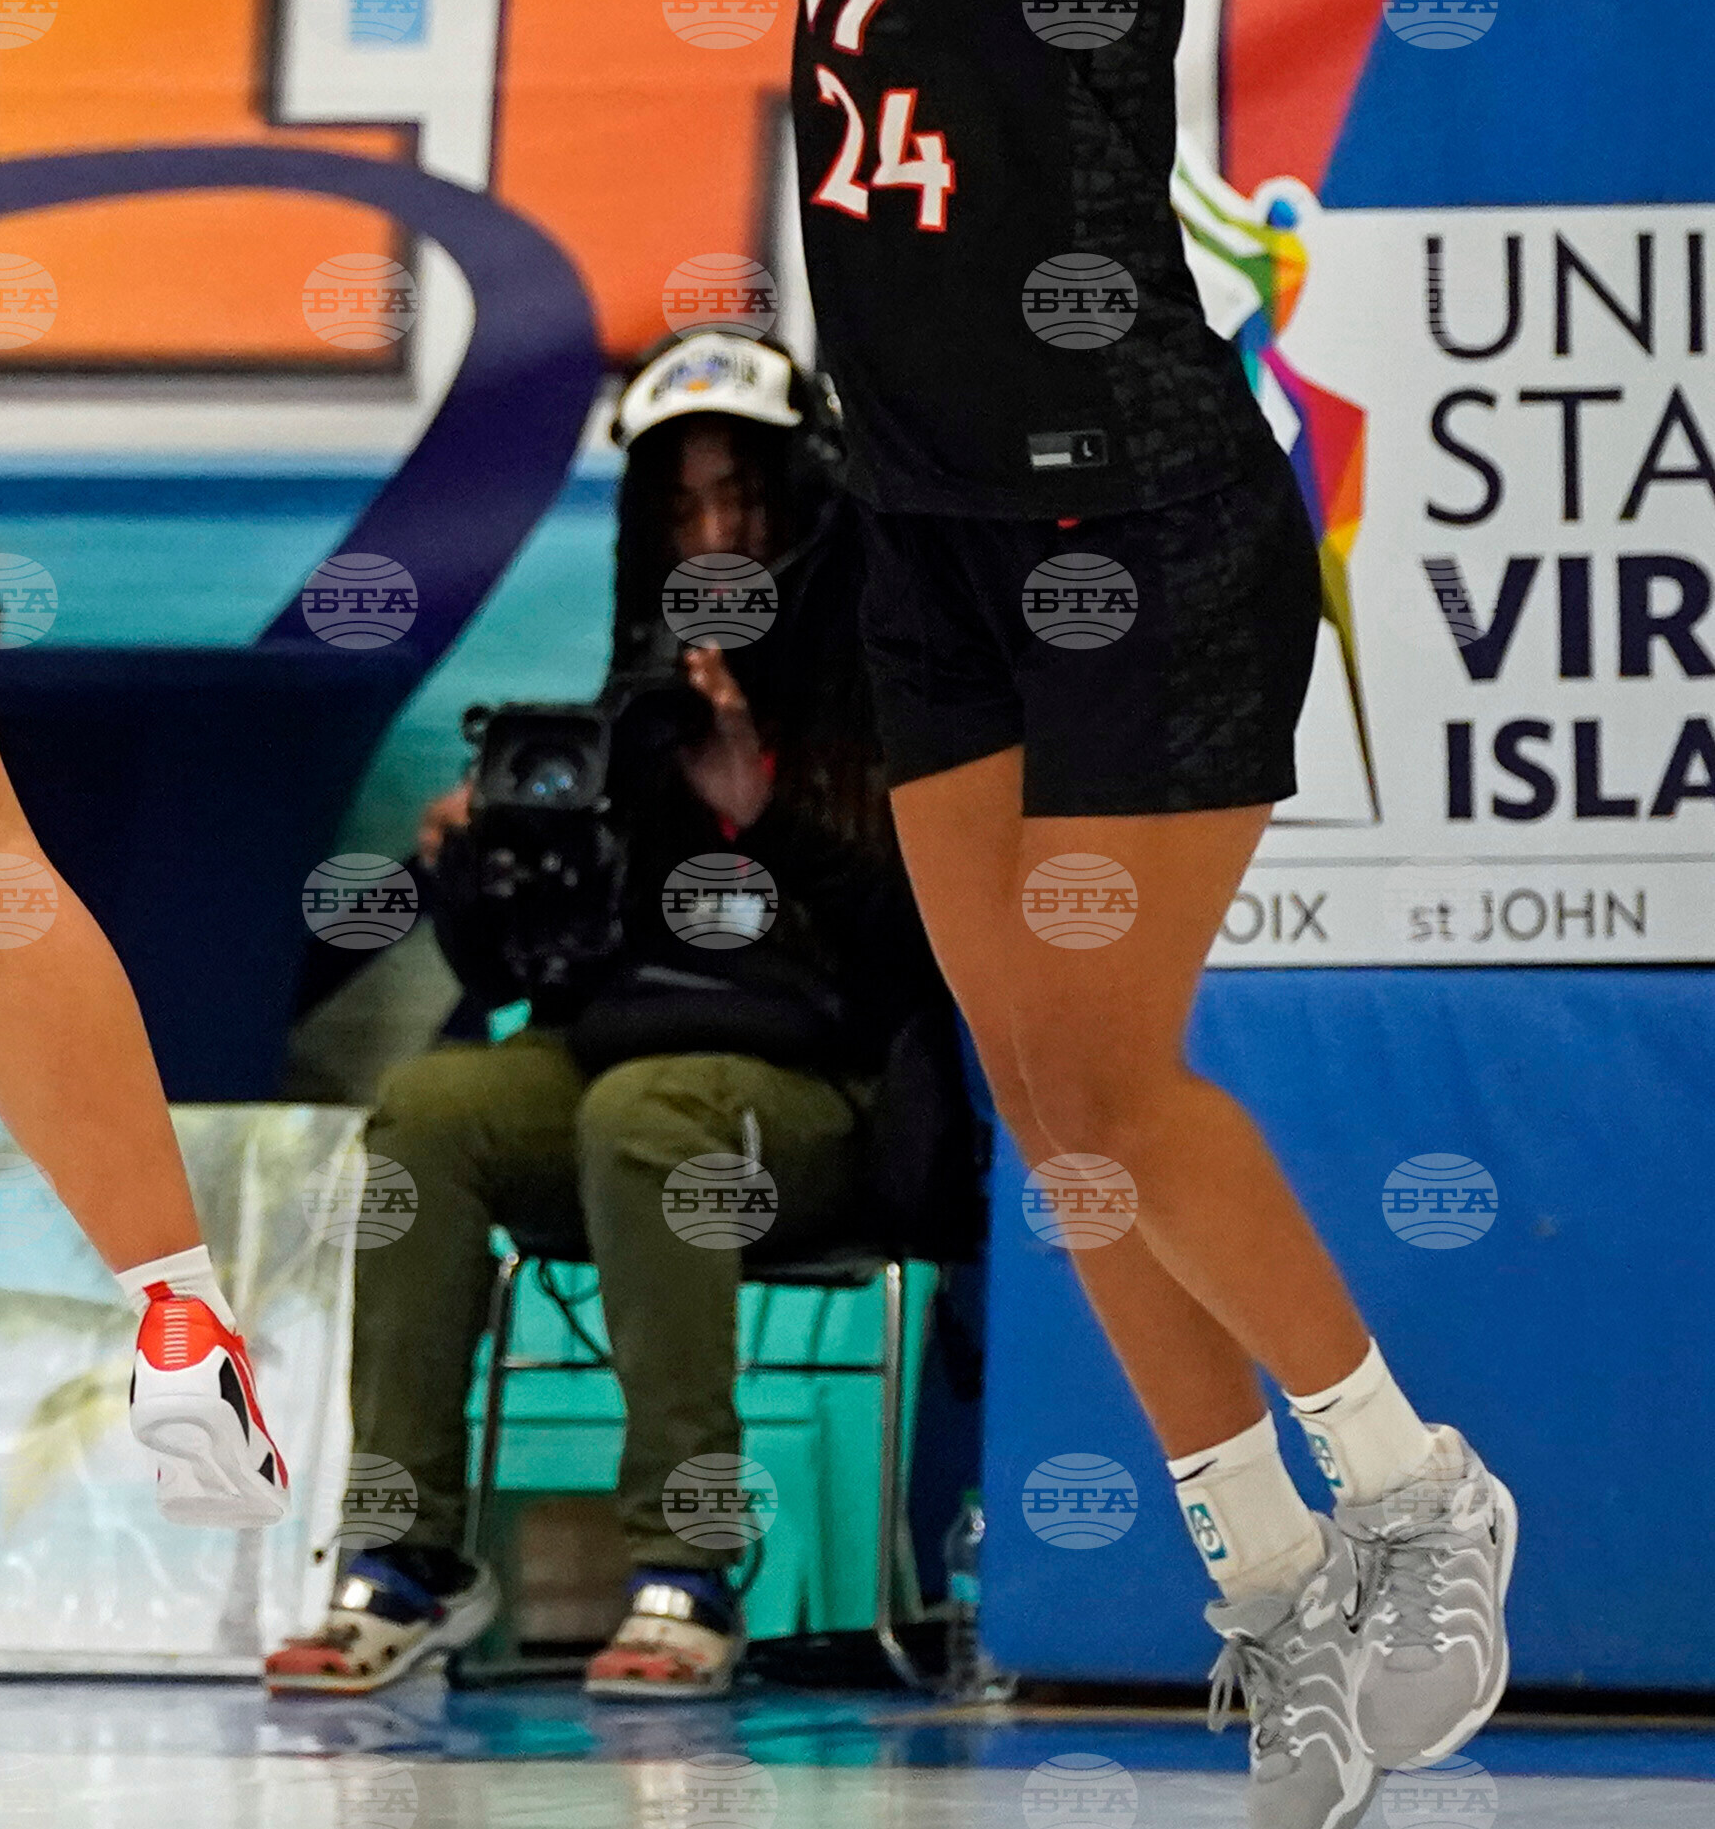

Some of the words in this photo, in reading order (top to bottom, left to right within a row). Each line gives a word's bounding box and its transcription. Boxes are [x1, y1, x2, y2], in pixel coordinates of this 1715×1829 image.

[809, 64, 956, 232] 24
[1425, 232, 1707, 360] UNI
[1426, 384, 1715, 525] STA
[1422, 554, 1715, 682] VIR
[1475, 888, 1646, 941] JOHN
